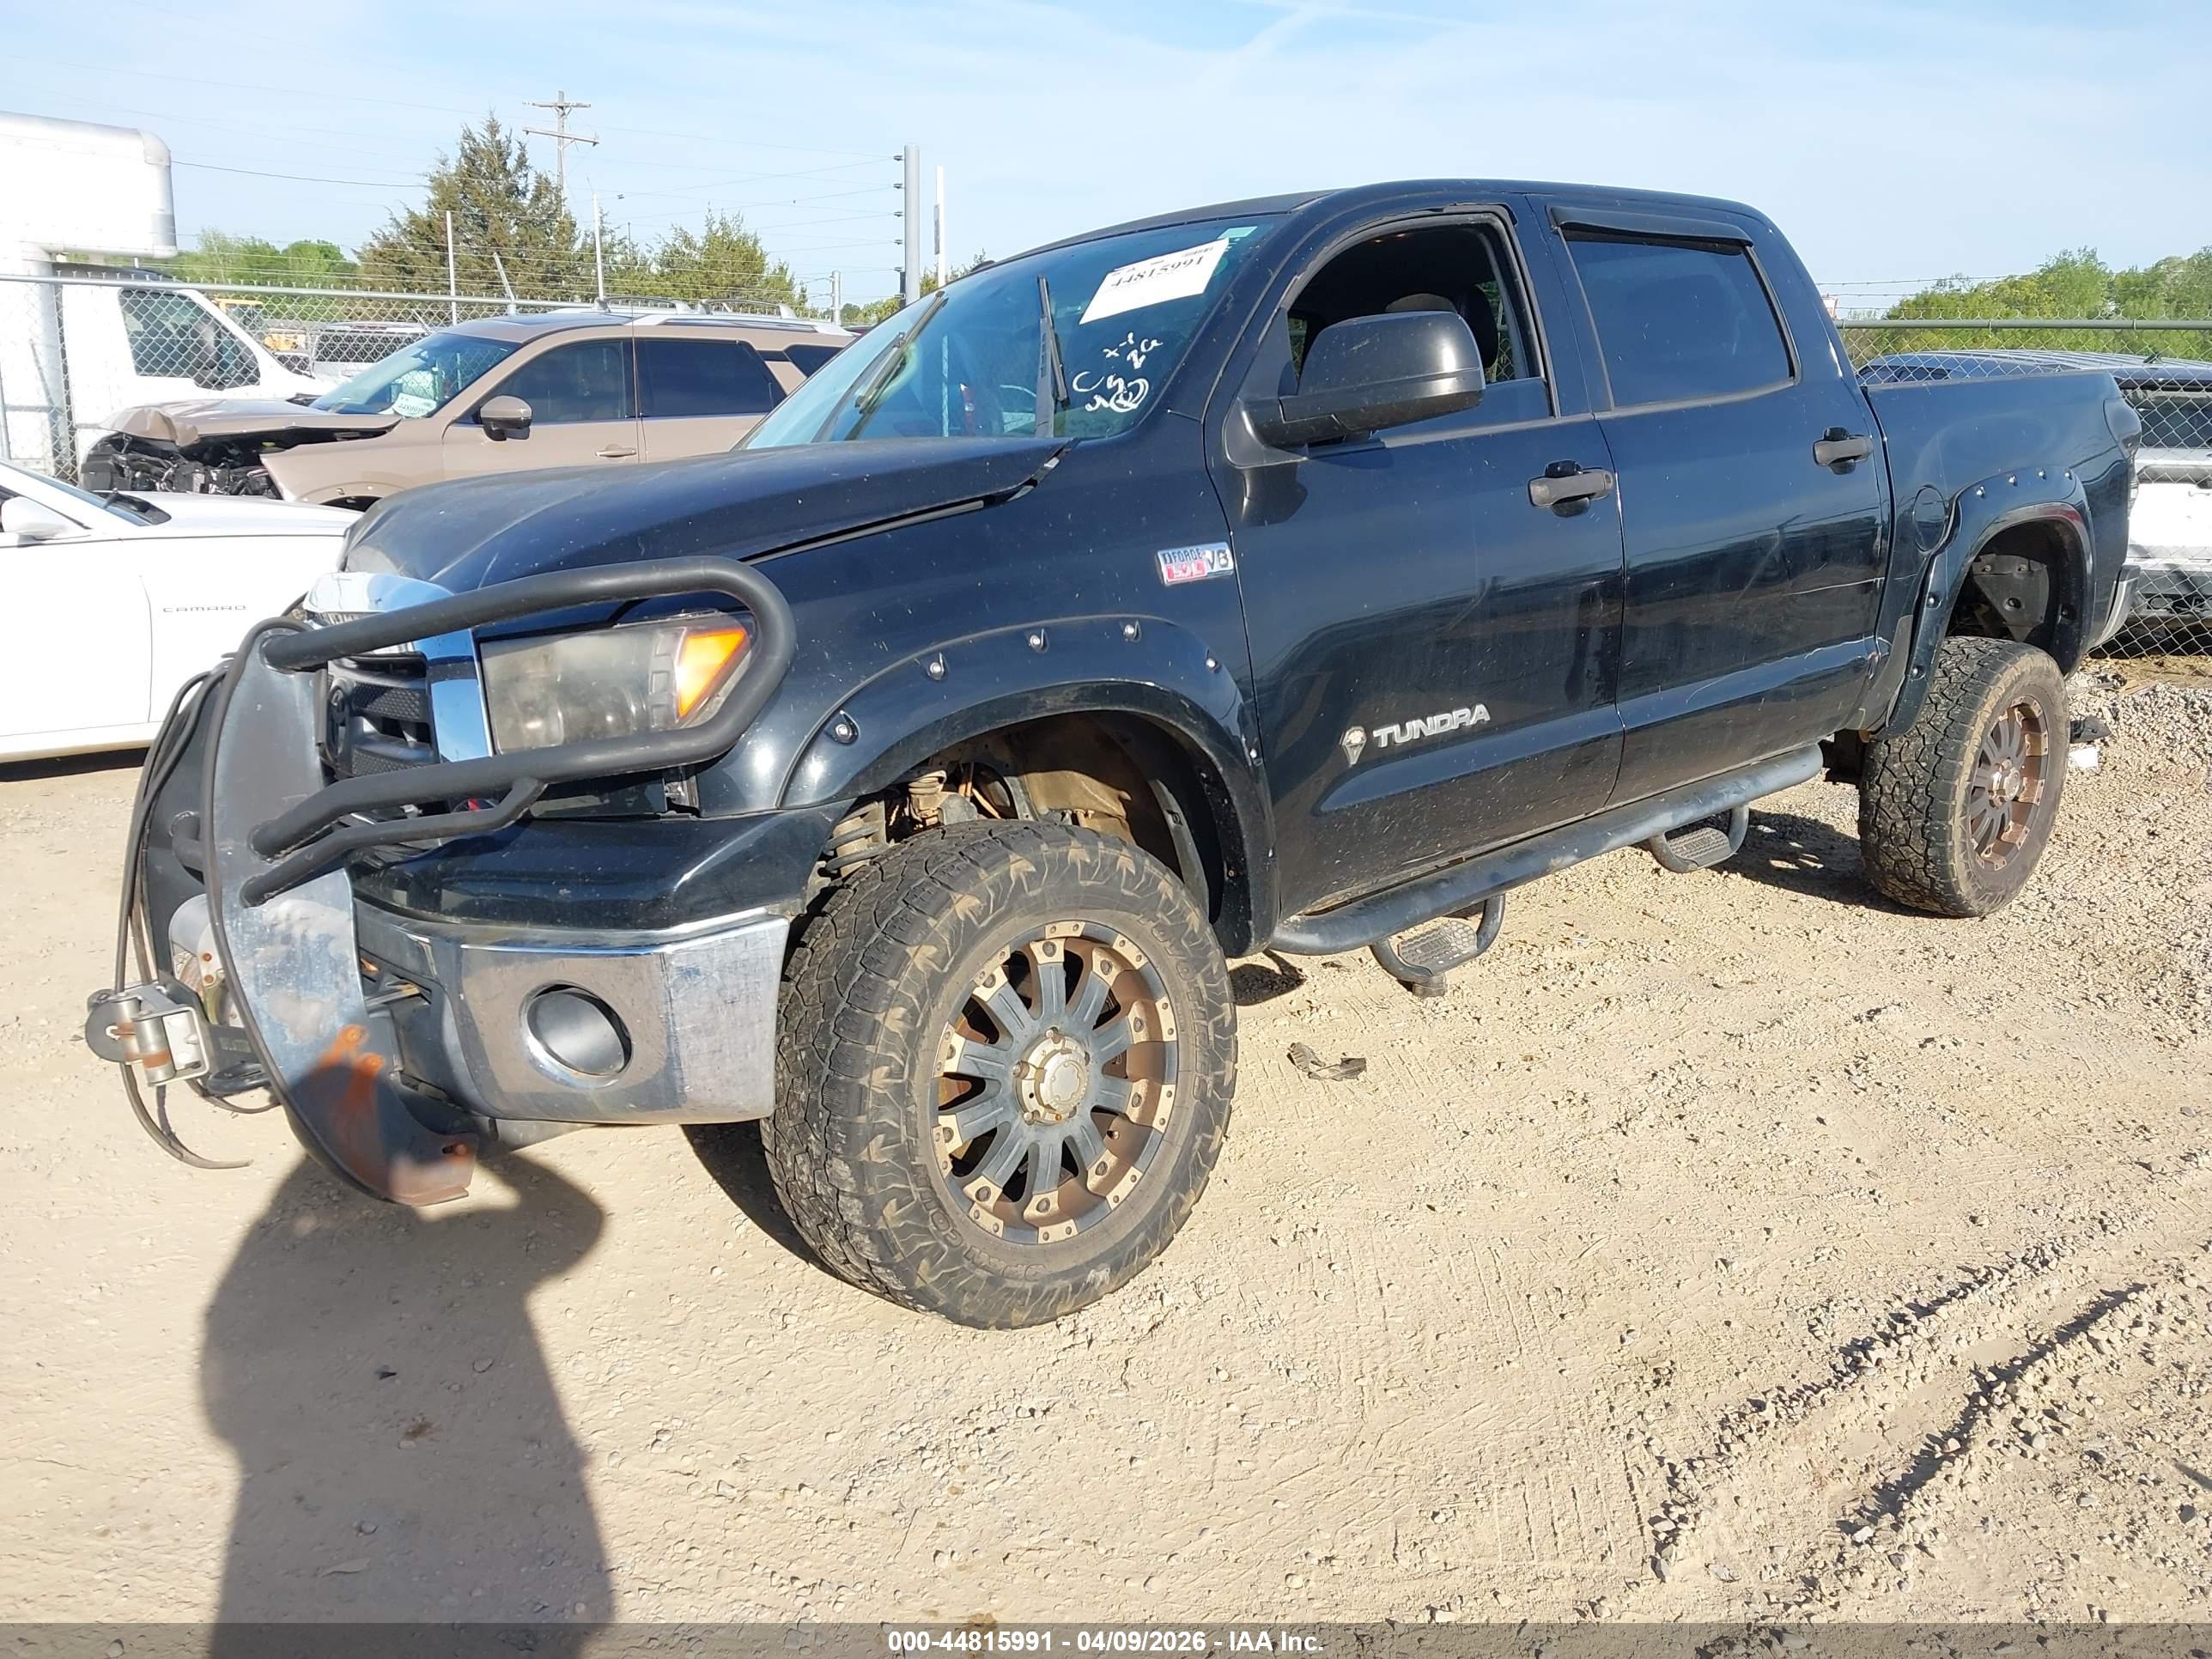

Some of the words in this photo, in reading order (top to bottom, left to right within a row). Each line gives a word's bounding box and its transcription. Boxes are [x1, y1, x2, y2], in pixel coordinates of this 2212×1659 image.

[1111, 255, 1204, 288] 44815991
[1206, 550, 1229, 571] V8
[1374, 703, 1491, 748] TUNDRA
